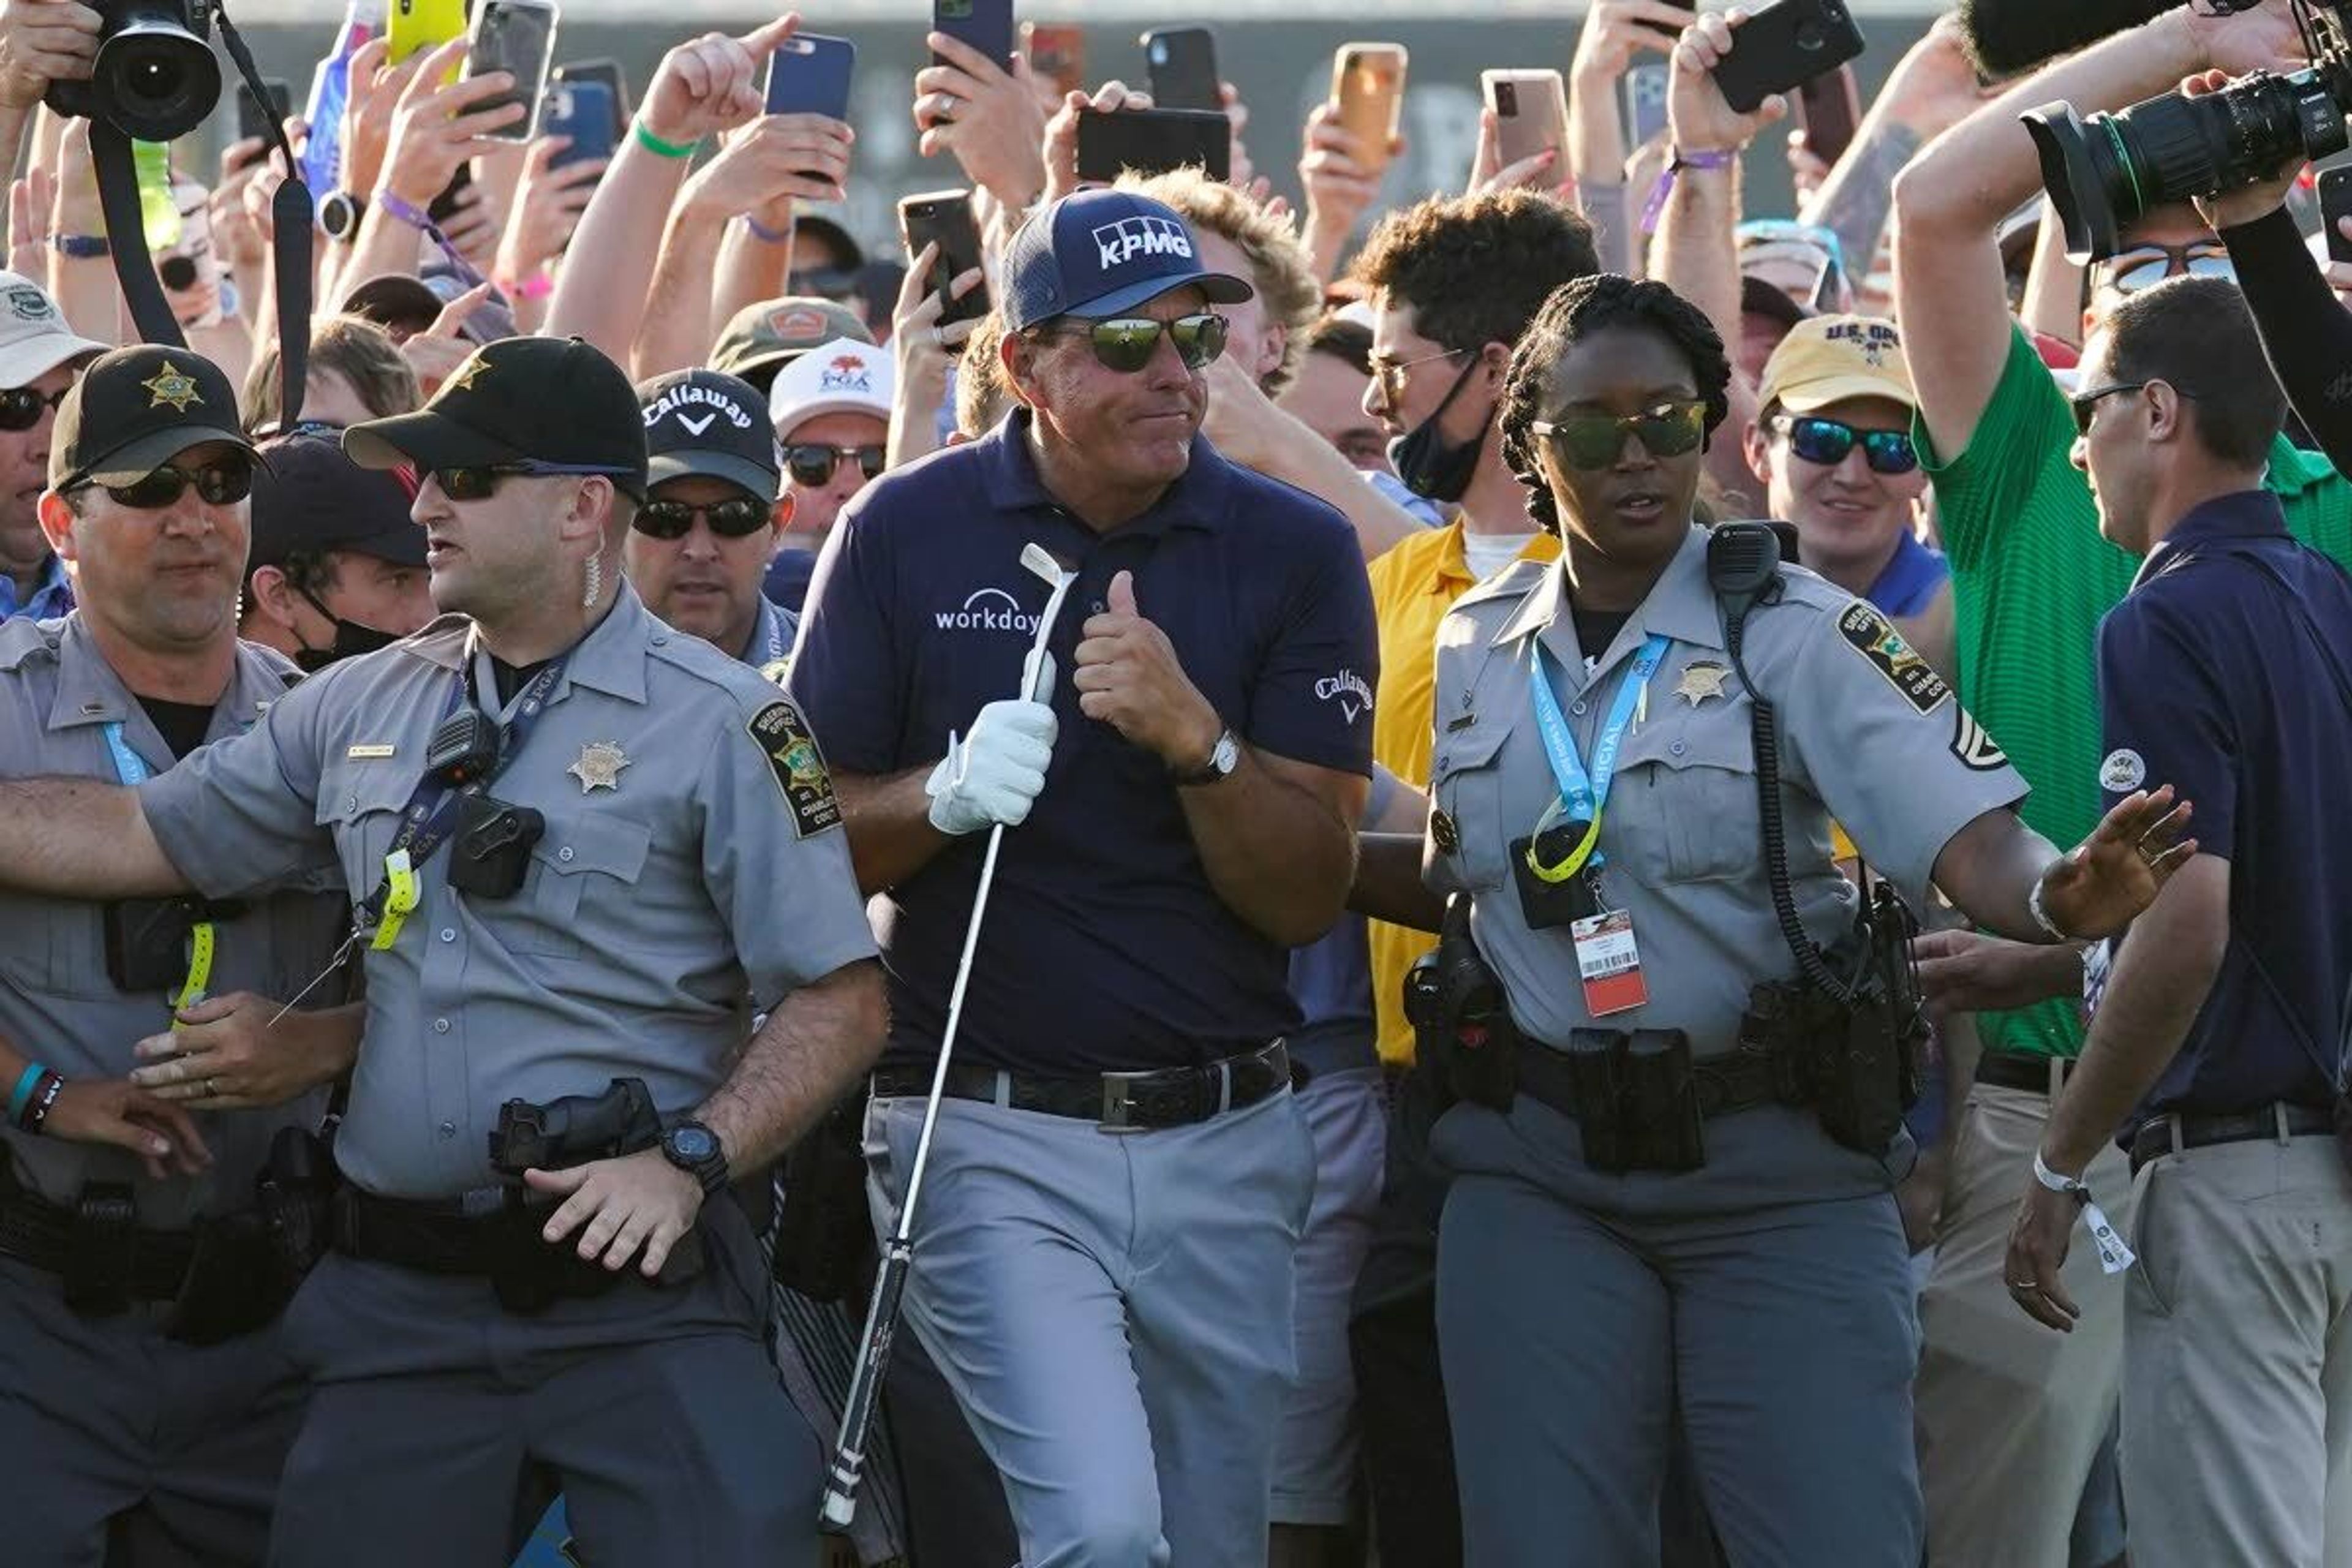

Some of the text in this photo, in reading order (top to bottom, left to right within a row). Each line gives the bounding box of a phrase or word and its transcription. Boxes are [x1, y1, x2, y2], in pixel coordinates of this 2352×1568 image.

[1101, 231, 1193, 270] KPMG
[641, 384, 752, 428] Callaway
[935, 607, 1041, 636] workday
